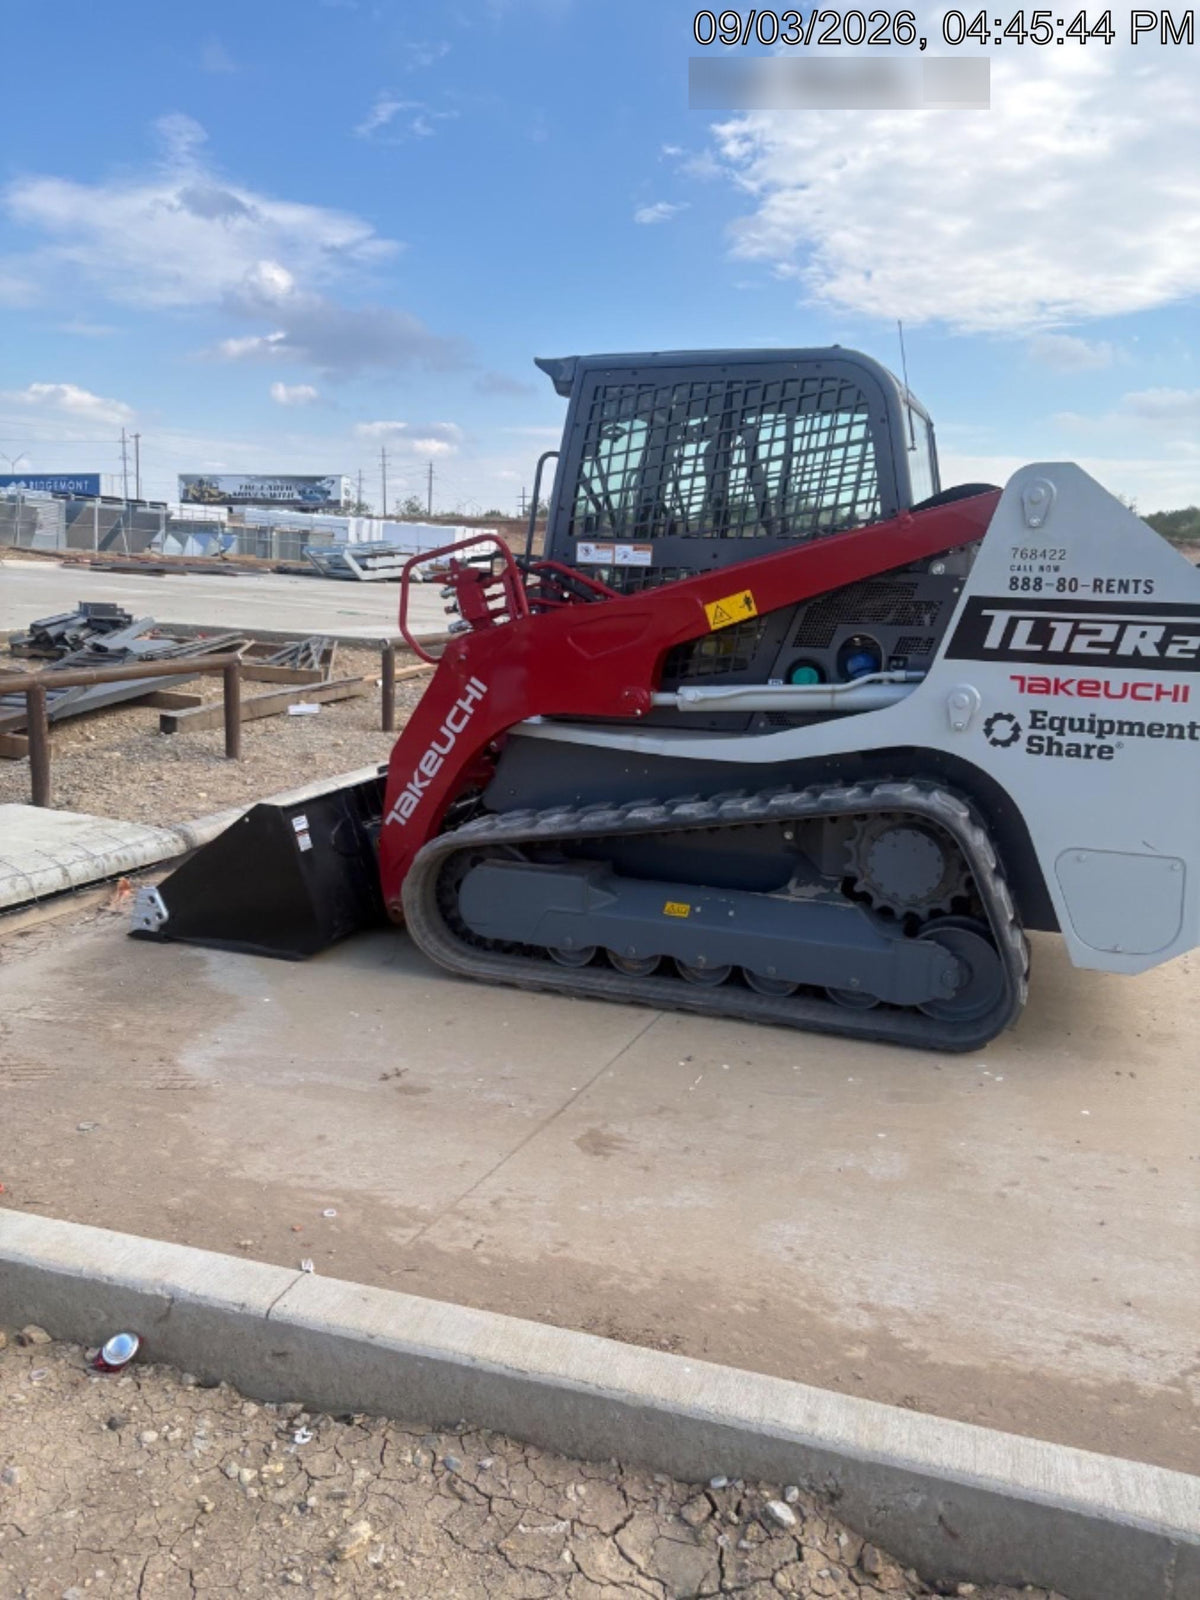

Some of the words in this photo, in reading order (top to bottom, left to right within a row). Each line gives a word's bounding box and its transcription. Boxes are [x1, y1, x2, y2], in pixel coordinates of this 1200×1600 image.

[1011, 547, 1067, 561] 768422
[1009, 564, 1034, 572] CALL
[1038, 565, 1061, 573] NOW
[1009, 576, 1155, 595] 888-80-RENTS
[1029, 709, 1200, 741] Equipment
